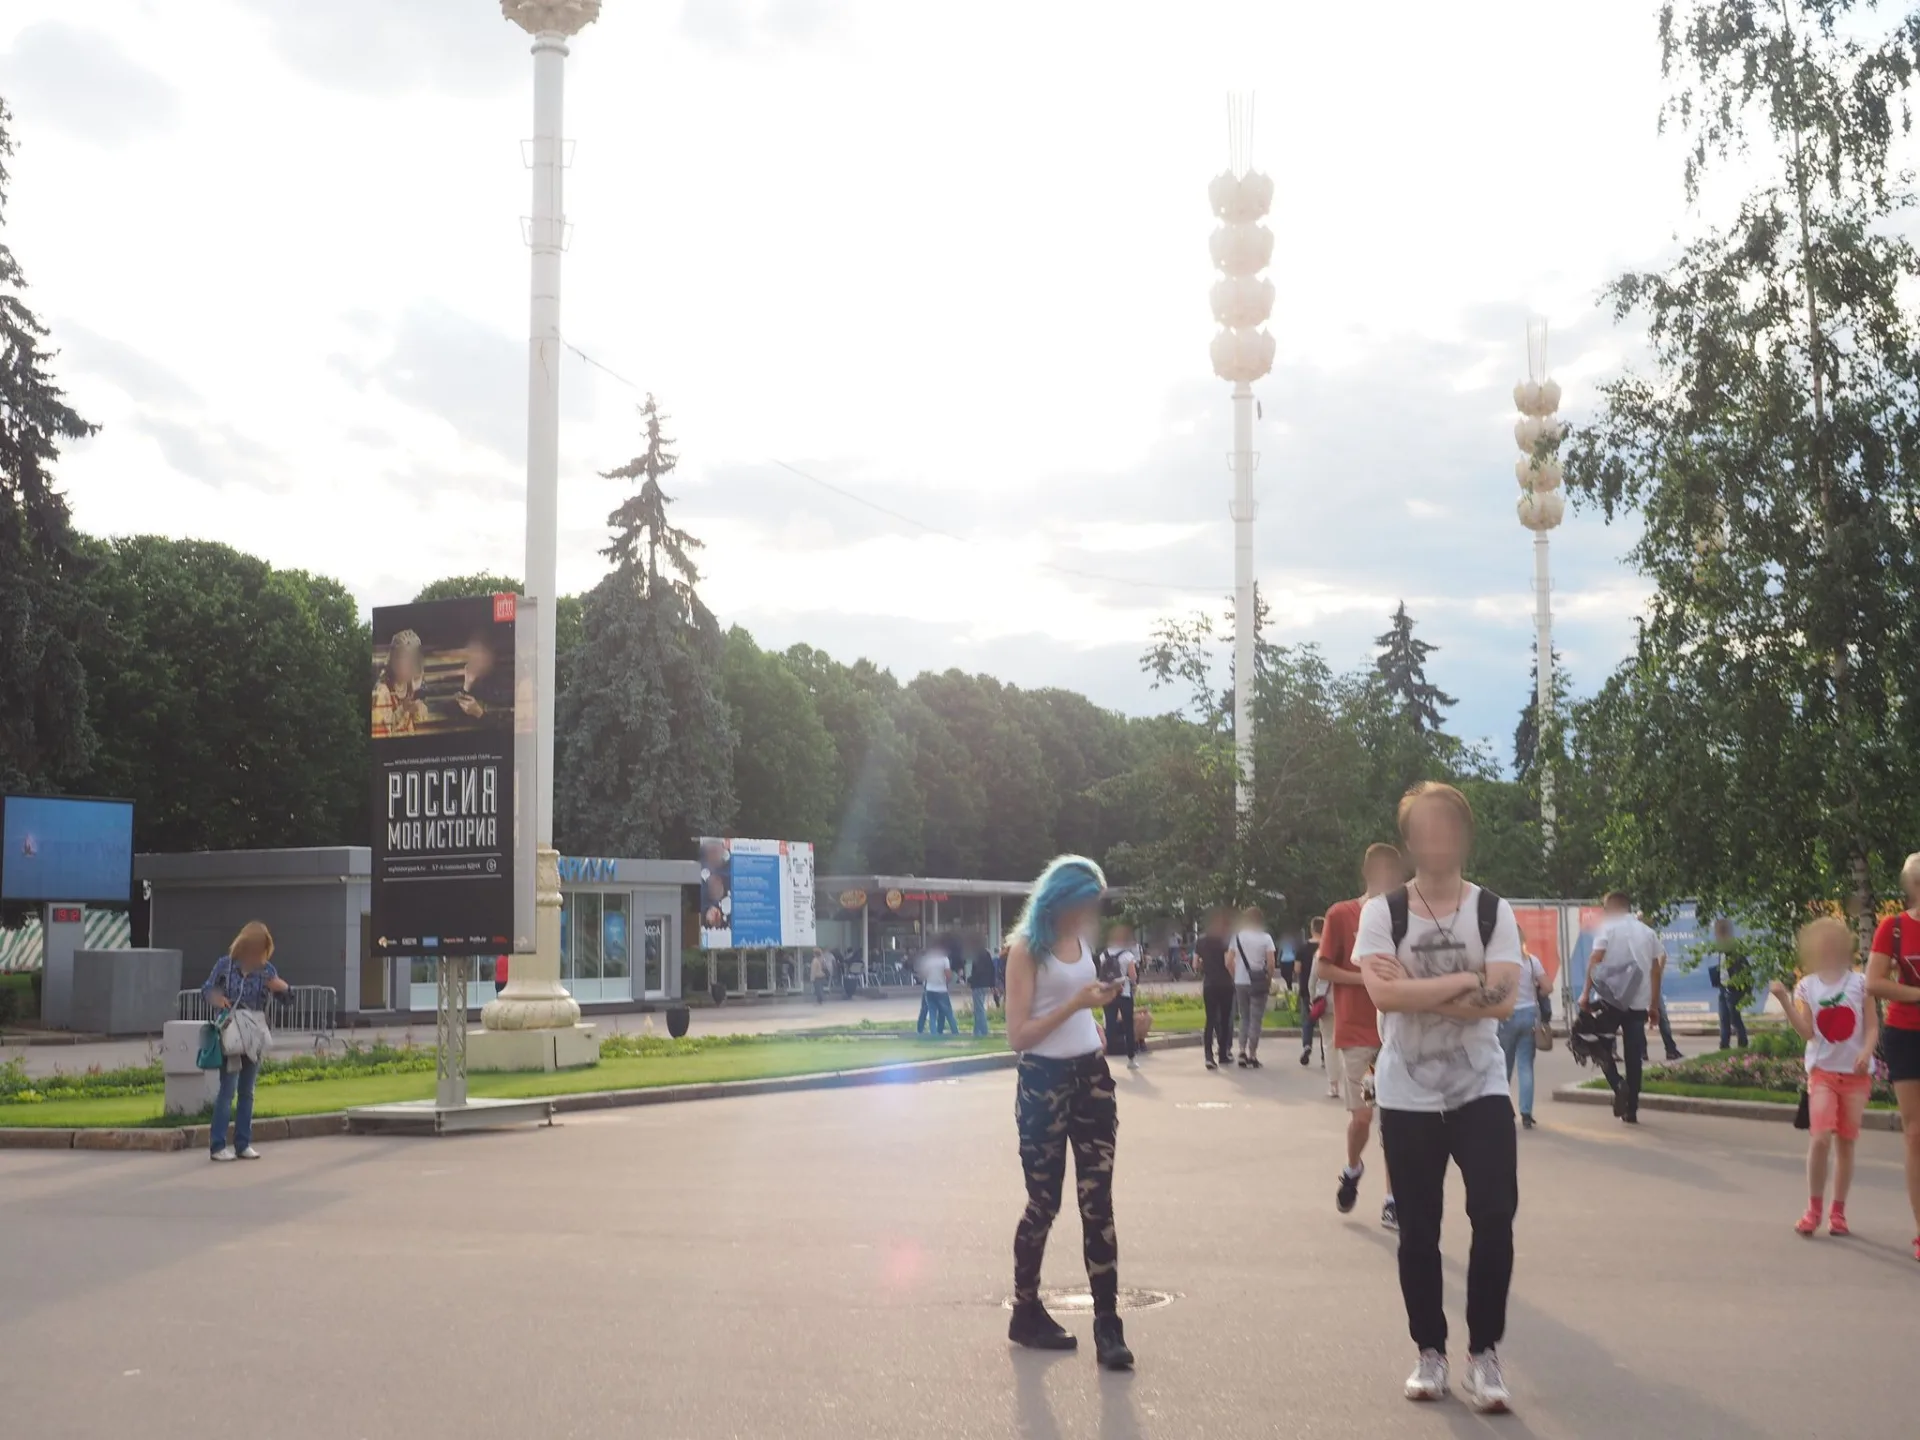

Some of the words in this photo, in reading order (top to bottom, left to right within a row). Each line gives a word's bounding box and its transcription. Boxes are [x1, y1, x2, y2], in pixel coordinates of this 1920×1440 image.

[388, 766, 498, 819] РОССИЯ
[387, 820, 421, 851] МОЯ
[425, 816, 497, 849] ИСТОРИЯ
